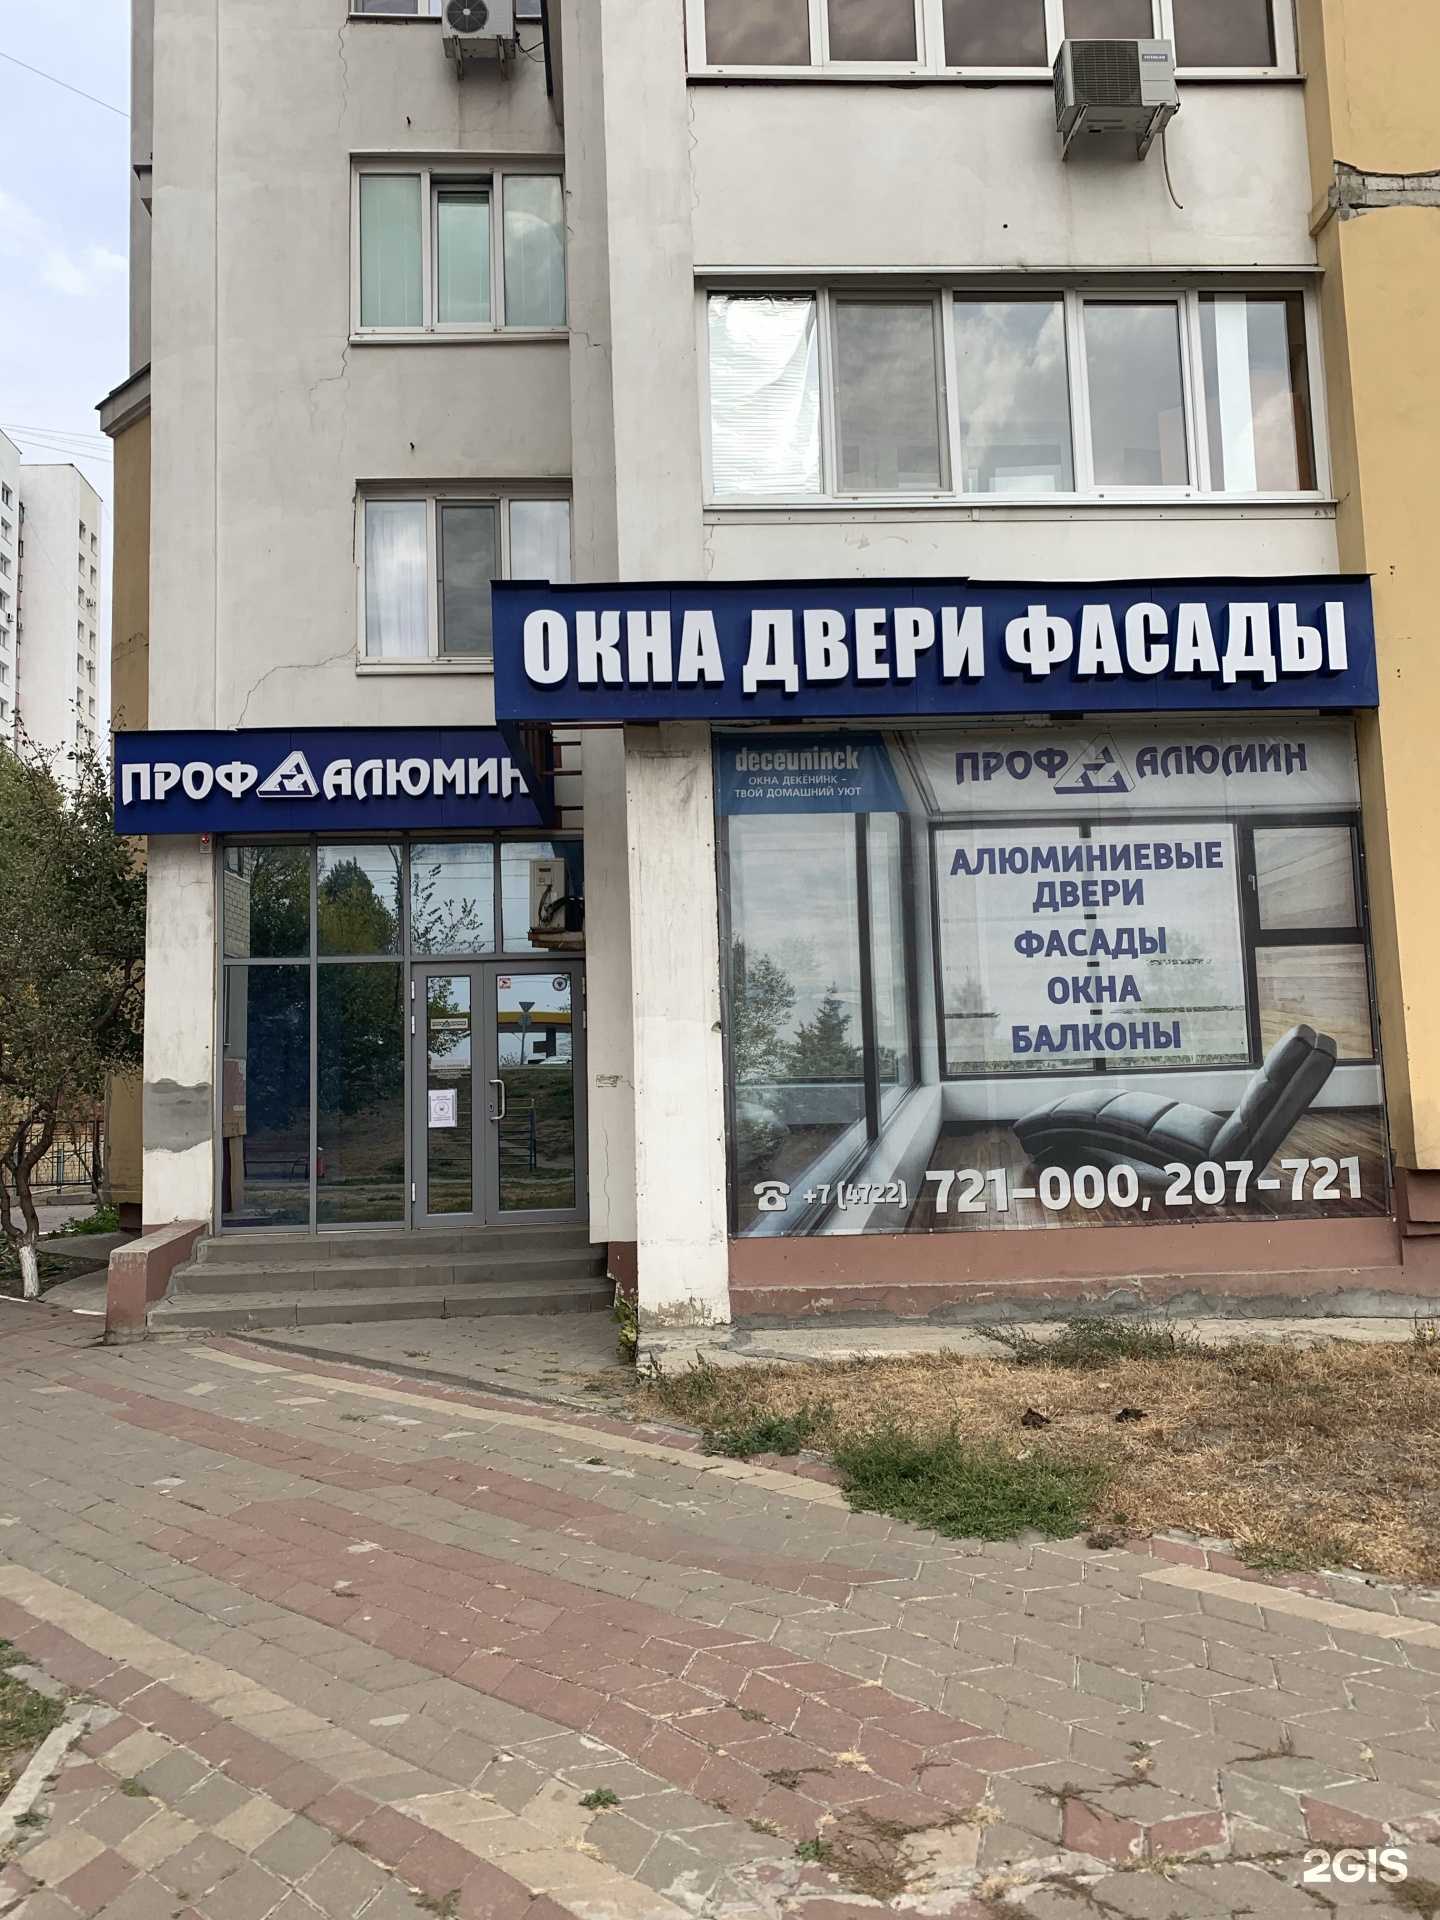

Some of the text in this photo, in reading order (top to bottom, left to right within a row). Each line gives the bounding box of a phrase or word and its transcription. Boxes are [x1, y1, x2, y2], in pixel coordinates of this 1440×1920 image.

[523, 601, 1348, 693] ОКНА ДВЕРИ ФАСАДЫ
[735, 745, 859, 771] deceuninck
[955, 743, 1308, 785] ПРОФ АЛЮМИН
[122, 757, 530, 806] ПРОФ АЛЮМИН
[735, 786, 862, 798] ТВОЙ ДОМАШНИЙ УЮТ
[748, 776, 779, 786] ОКНА
[950, 841, 1224, 876] АЛЮМИНИЕВЫЕ
[1032, 879, 1144, 913] ДВЕРИ
[1014, 926, 1167, 960] ФАСАДЫ
[1047, 974, 1142, 1005] ОКНА
[1011, 1021, 1182, 1053] БАЛКОНЫ
[803, 1156, 1362, 1213] +7 (4722) 721-000, 207-721
